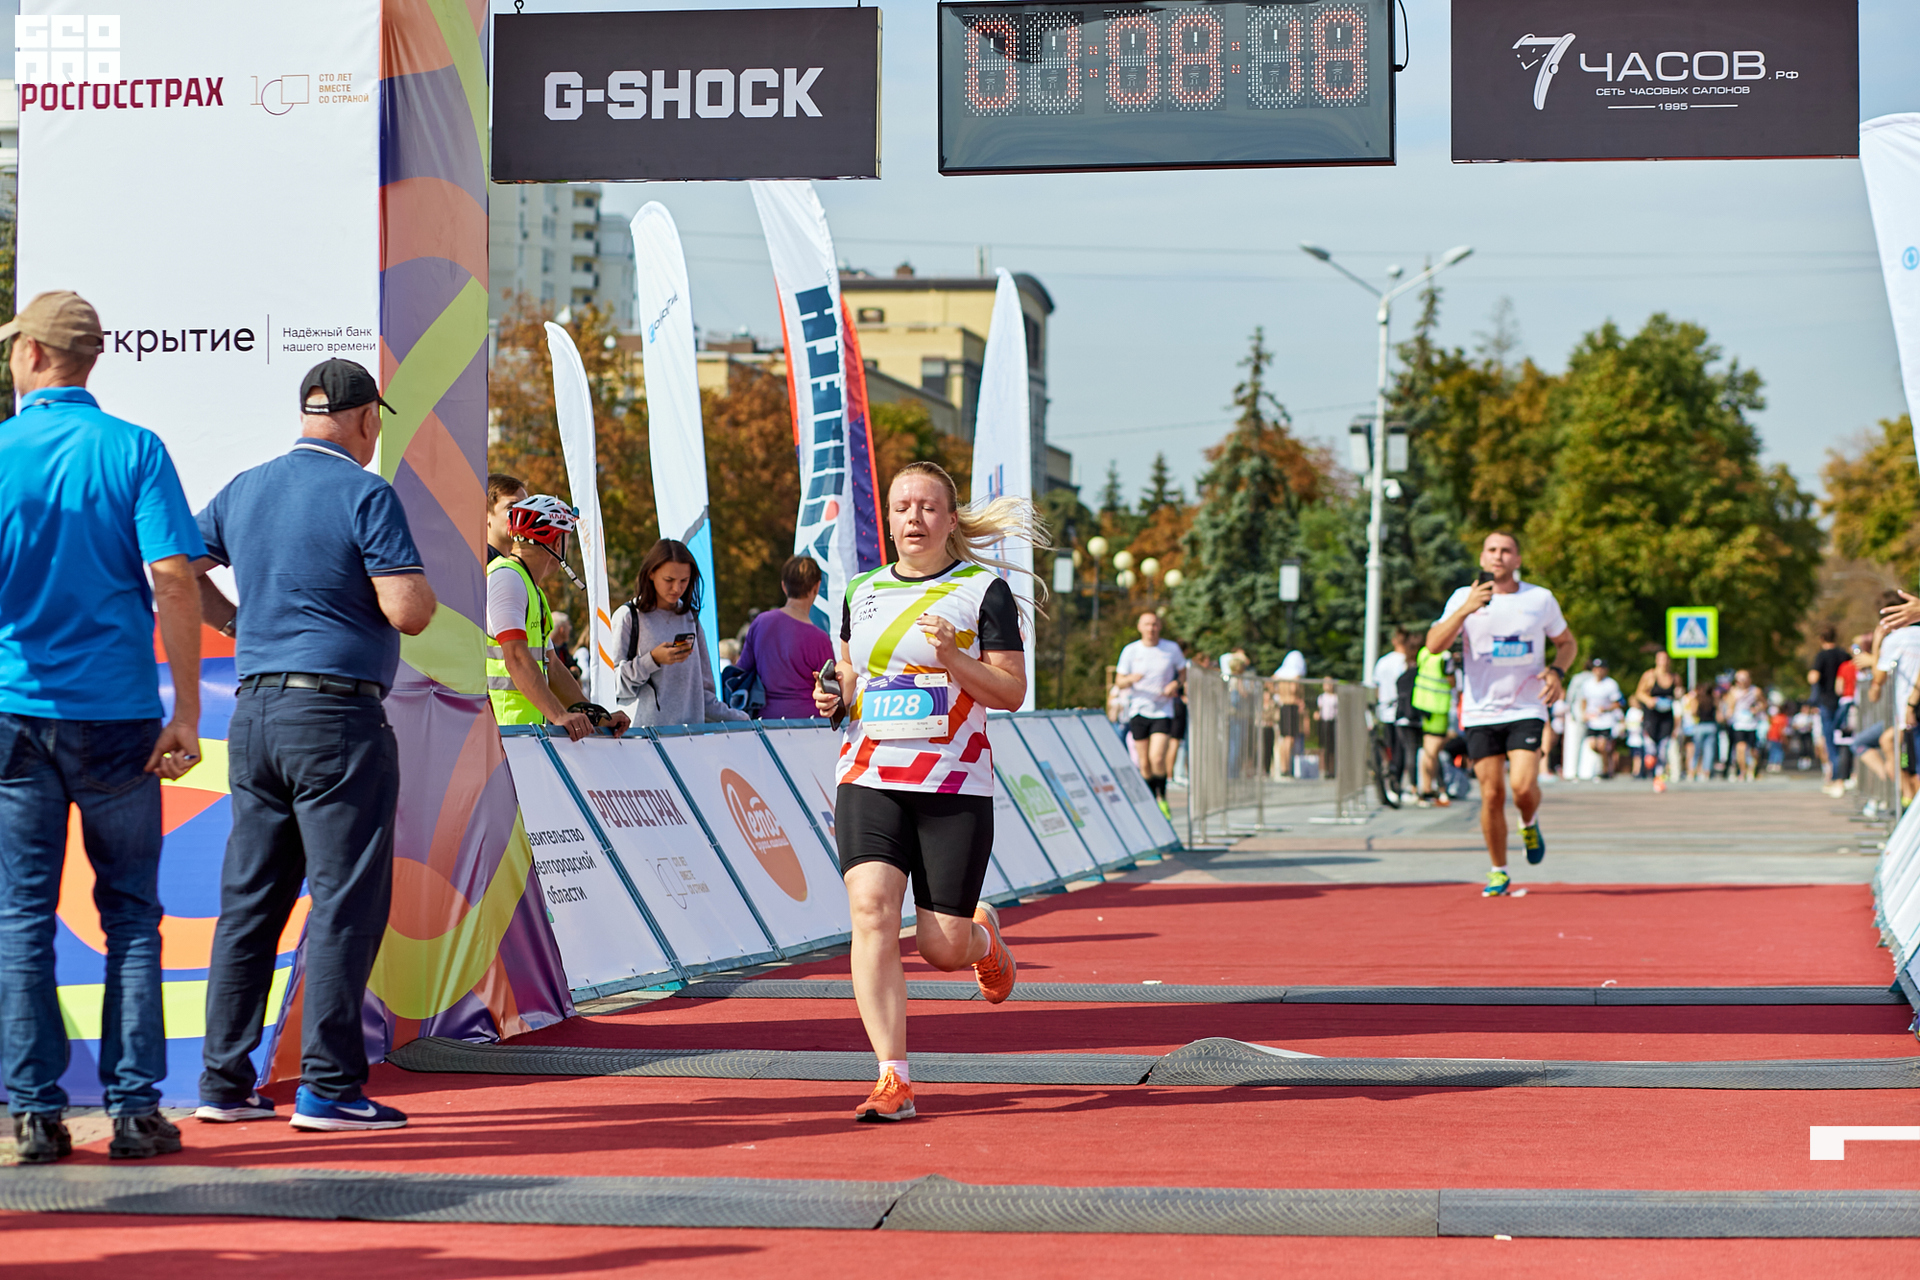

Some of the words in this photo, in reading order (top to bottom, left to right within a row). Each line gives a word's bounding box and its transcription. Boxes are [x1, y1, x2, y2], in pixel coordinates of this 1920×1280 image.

[319, 73, 335, 82] СТО
[337, 73, 353, 81] ЛЕТ
[21, 76, 224, 112] РОСГОССТРАХ
[319, 84, 352, 92] ВМЕСТЕ
[544, 67, 824, 121] G-SHOCK
[1596, 88, 1626, 96] СЕТЬ
[1629, 87, 1688, 96] ЧАСОВЫХ
[1692, 86, 1750, 95] САЛОНОВ
[318, 95, 331, 104] СО
[332, 93, 370, 103] СТРАНОЙ
[1658, 103, 1688, 111] 1995
[282, 326, 343, 339] Надёжный
[346, 326, 373, 338] банк
[282, 342, 324, 352] нашего
[327, 341, 377, 353] времени
[873, 694, 921, 718] 1128
[587, 788, 688, 829] РОСГОССТРАХ
[546, 884, 588, 905] области
